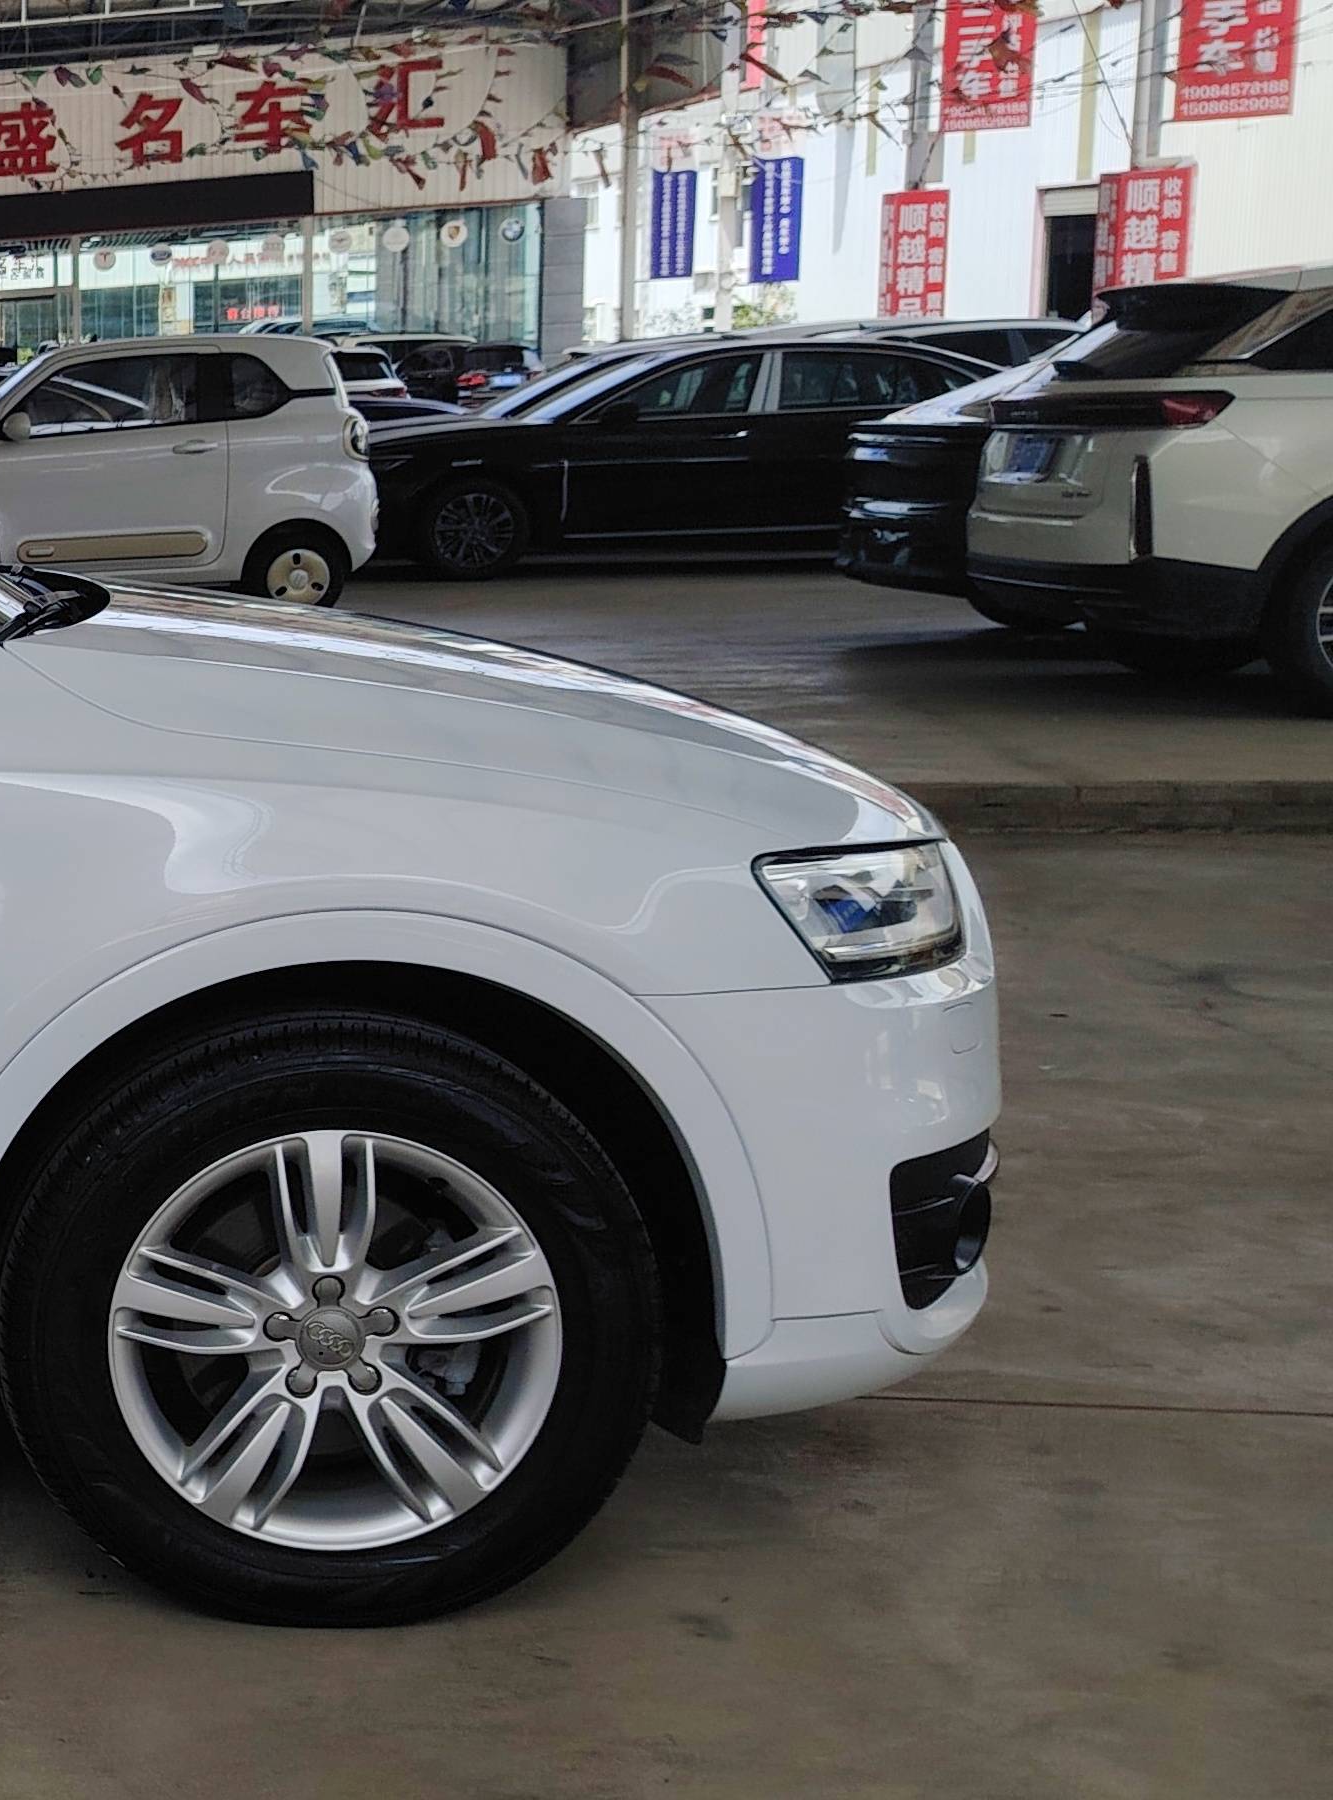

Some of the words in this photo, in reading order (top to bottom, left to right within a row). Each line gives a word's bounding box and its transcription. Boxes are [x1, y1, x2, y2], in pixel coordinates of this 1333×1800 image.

[956, 0, 997, 100] 二手车
[1162, 176, 1183, 219] 收购
